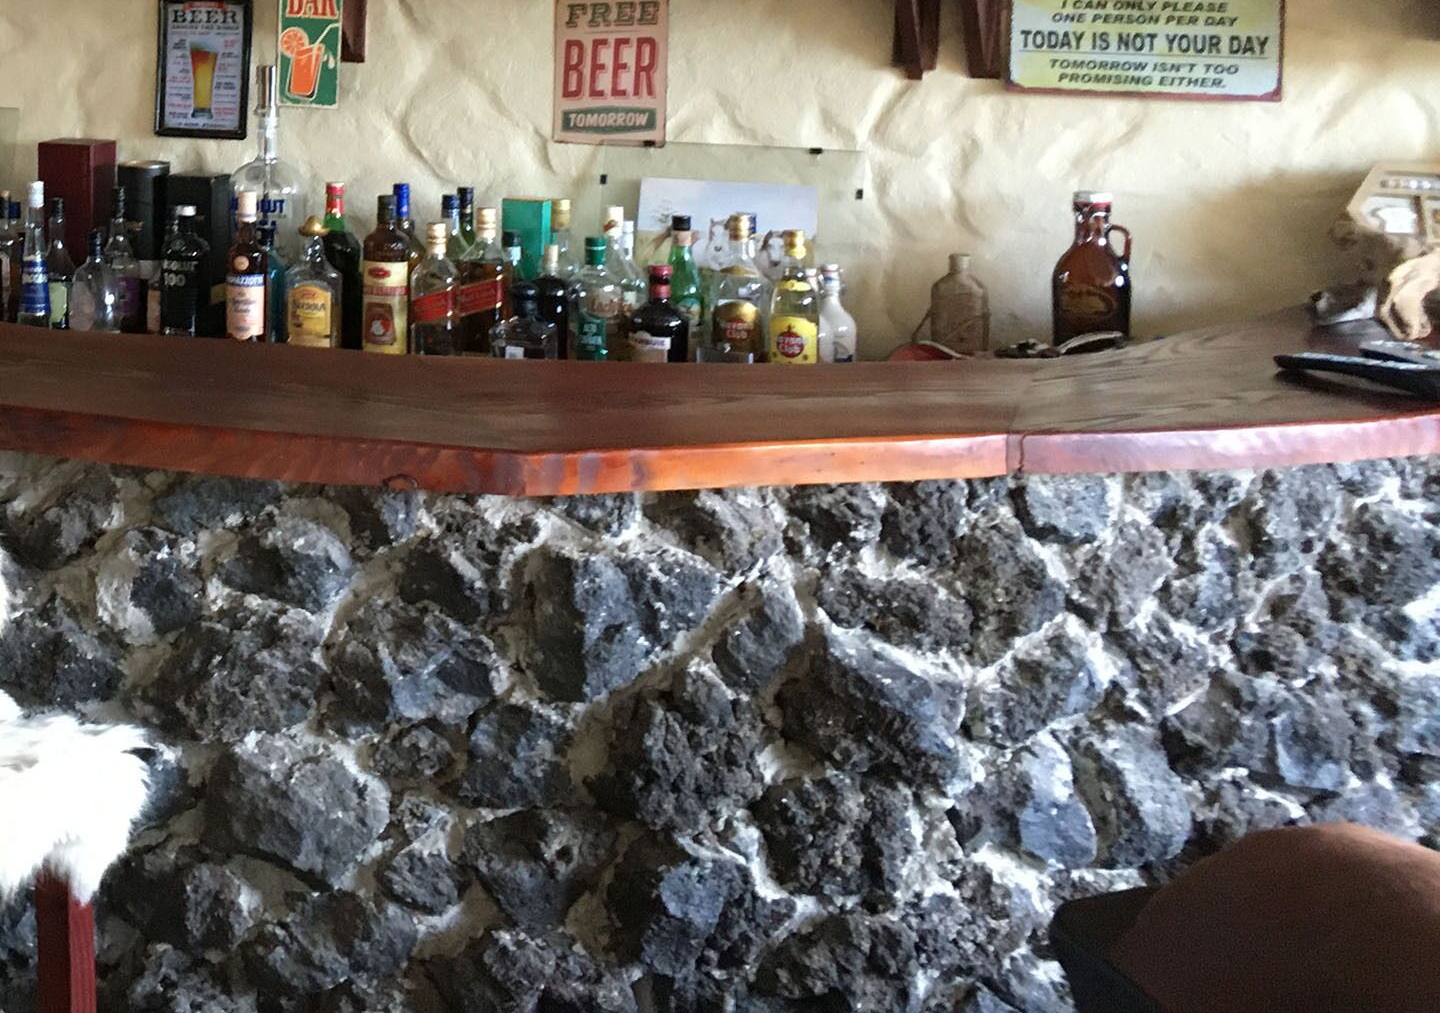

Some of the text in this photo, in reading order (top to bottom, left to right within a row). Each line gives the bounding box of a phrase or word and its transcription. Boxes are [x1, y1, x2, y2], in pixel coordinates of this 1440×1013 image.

[565, 0, 660, 28] FREE
[1061, 0, 1229, 13] I CAN ONLY PLEASE
[172, 9, 238, 24] BEER
[1051, 12, 1239, 27] ONE PERSON PER DAY
[1020, 29, 1270, 56] TODAY IS NOT YOUR DAY
[562, 36, 658, 100] BEER
[1049, 58, 1240, 75] TOMORROW ISN'T TOO
[1057, 72, 1154, 86] PROMISING
[568, 112, 650, 128] TOMORROW
